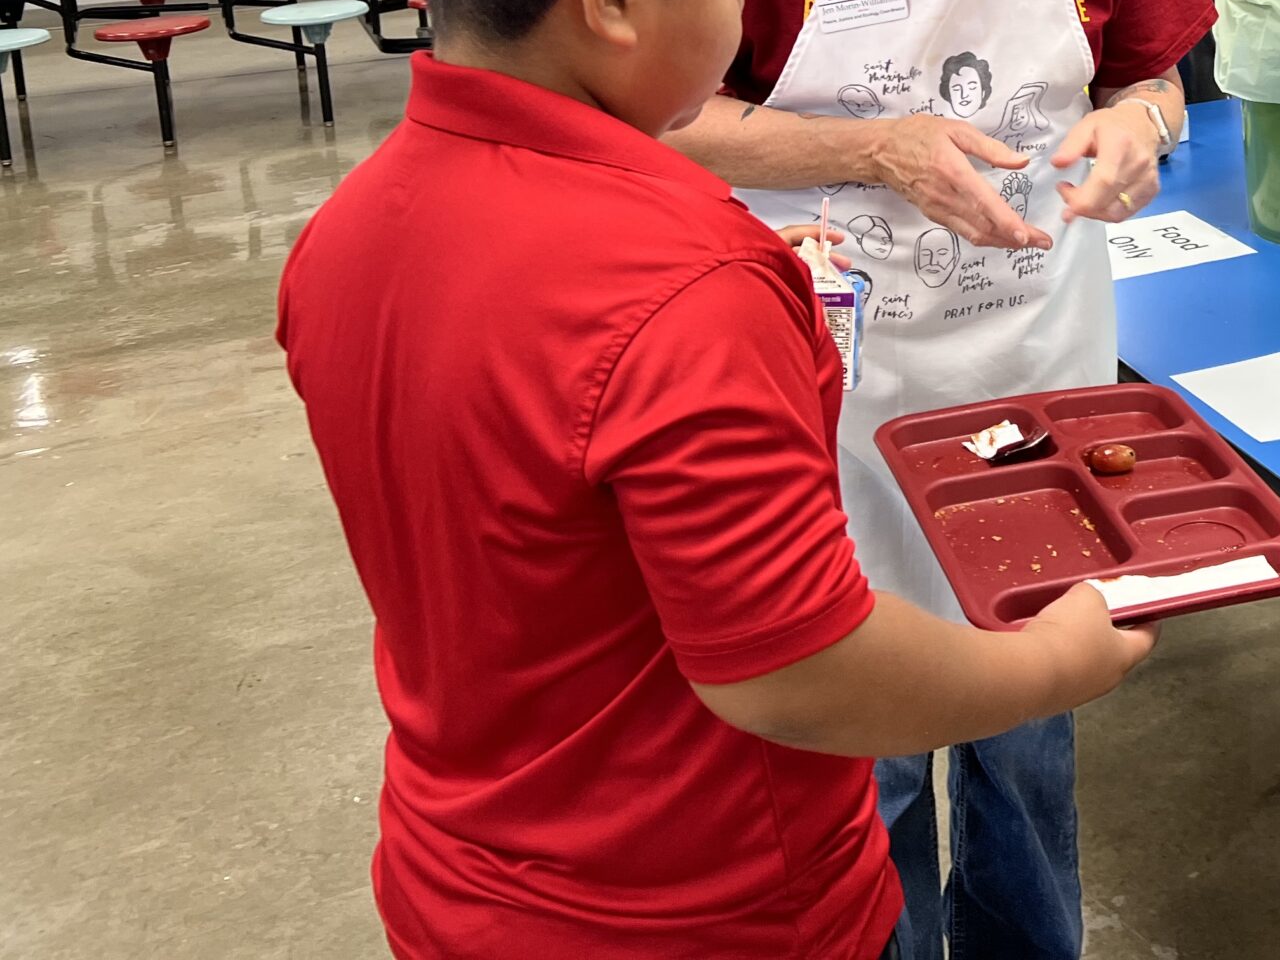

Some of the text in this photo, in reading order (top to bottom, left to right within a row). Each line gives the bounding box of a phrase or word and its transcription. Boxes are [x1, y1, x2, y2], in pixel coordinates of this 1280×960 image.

[822, 7, 835, 16] Jen
[1108, 235, 1154, 259] Only
[1153, 225, 1209, 252] Food
[944, 294, 1028, 320] PRAY FOR US.
